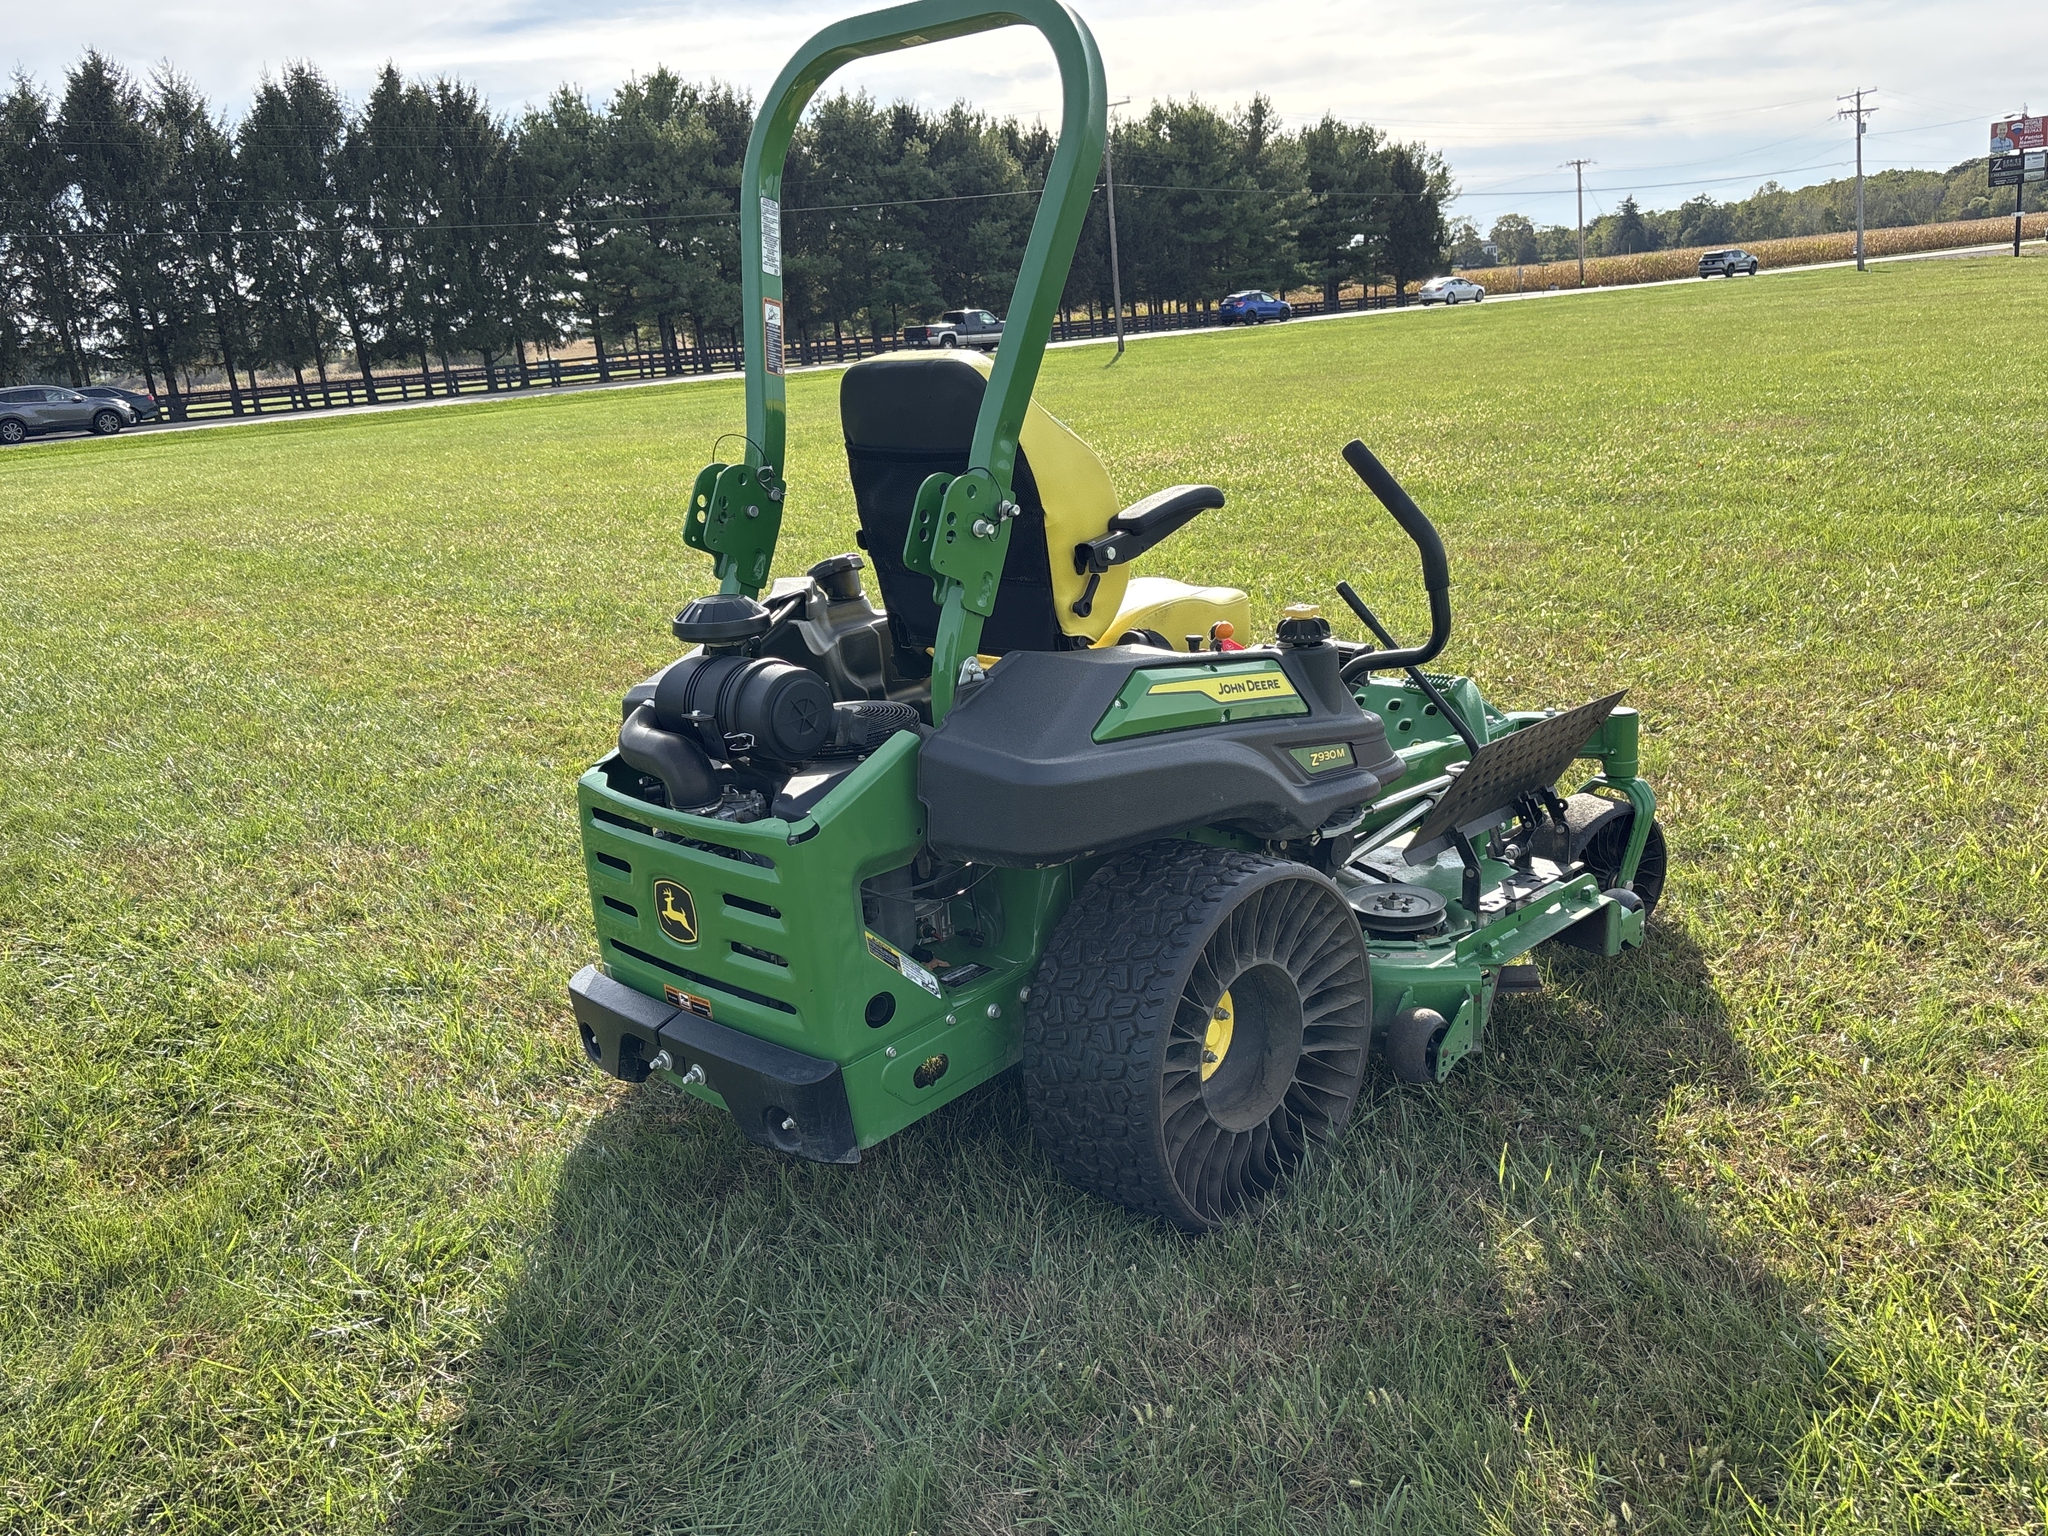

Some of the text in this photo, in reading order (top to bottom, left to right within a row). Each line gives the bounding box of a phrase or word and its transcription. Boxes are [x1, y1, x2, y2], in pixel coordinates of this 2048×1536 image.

[1218, 679, 1281, 695] JOHN DEERE
[1310, 748, 1346, 766] Z930M
